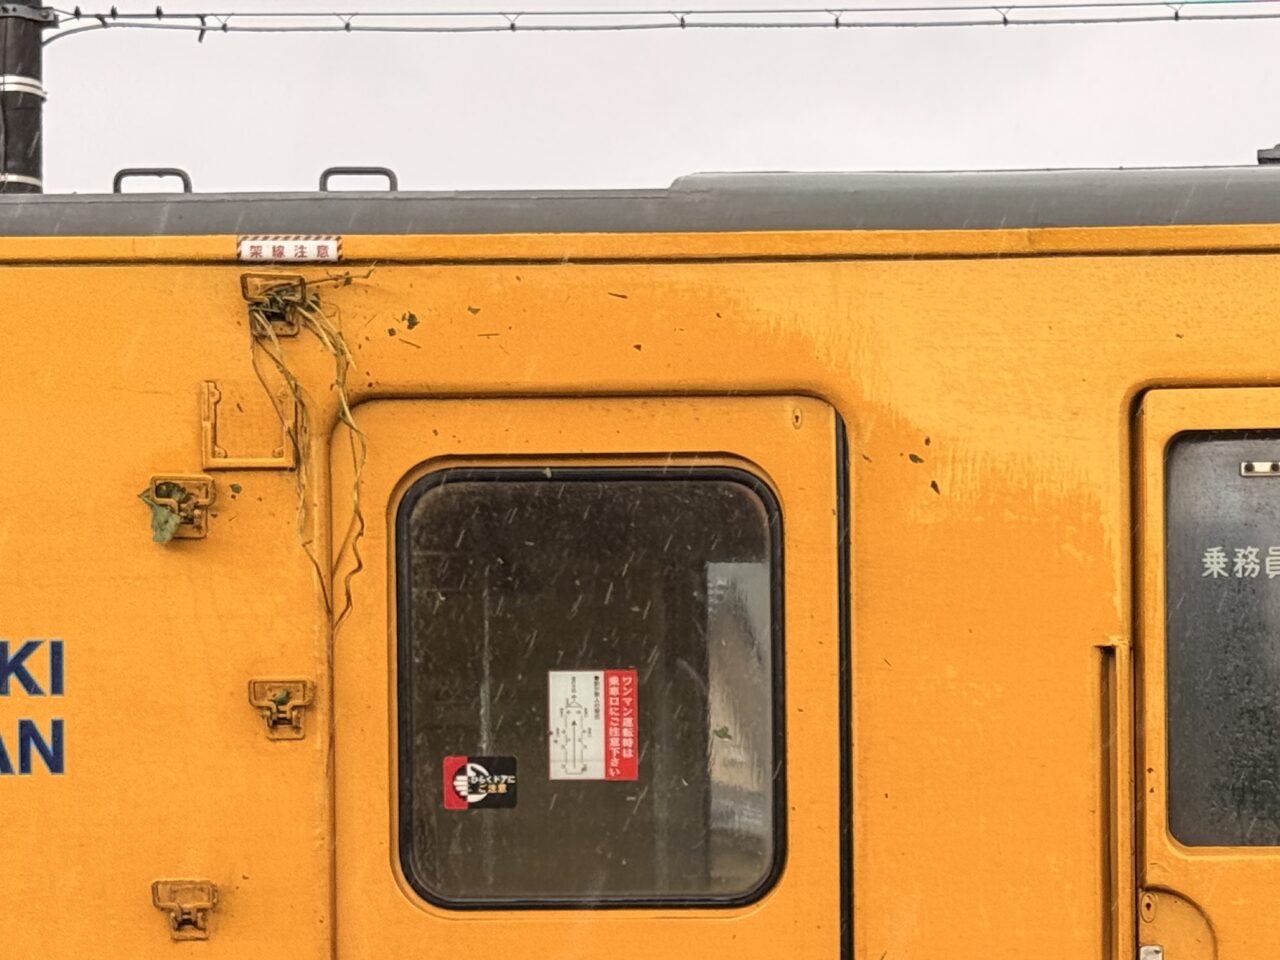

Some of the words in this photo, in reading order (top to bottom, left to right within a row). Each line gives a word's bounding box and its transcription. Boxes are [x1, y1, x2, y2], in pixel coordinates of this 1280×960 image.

[249, 244, 330, 258] 架線注意
[621, 676, 635, 759] ワンマン運転時は
